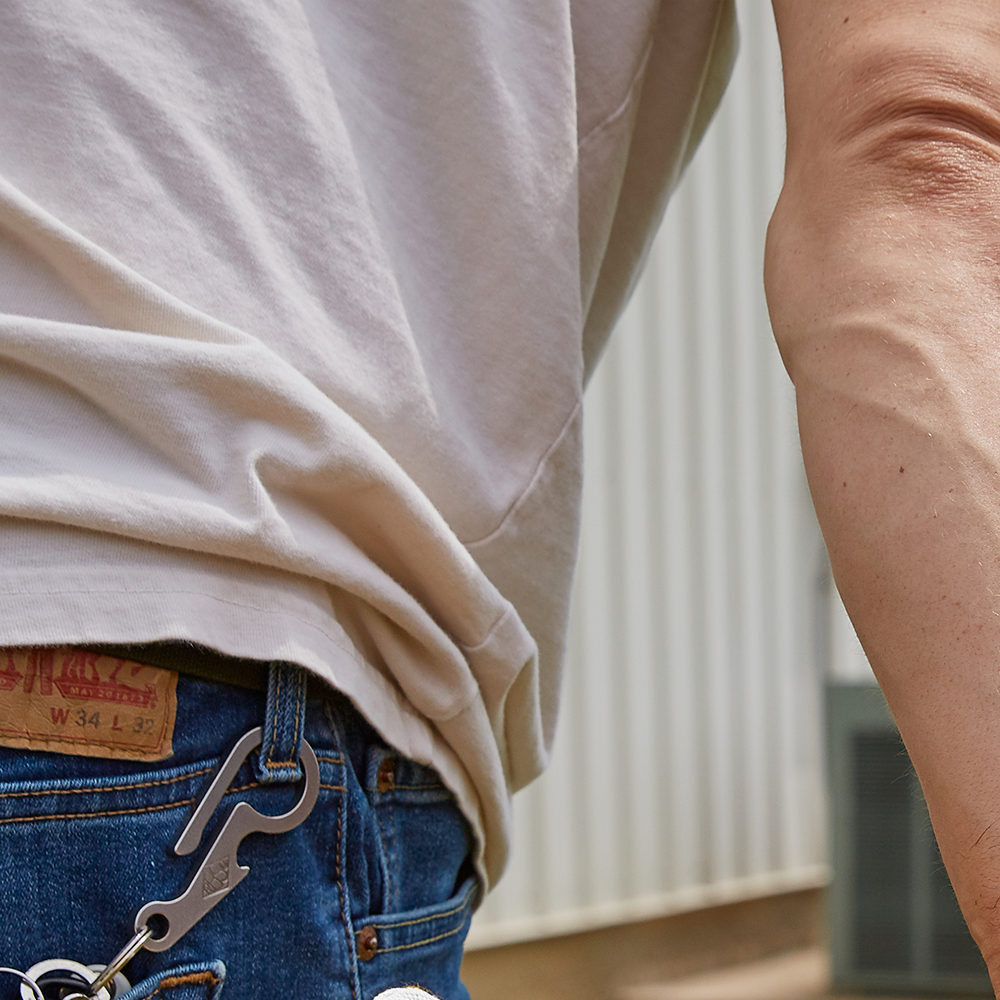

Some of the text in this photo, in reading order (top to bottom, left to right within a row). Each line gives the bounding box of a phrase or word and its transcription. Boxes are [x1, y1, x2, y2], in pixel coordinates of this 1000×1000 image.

[51, 707, 154, 736] W 34 L 32
